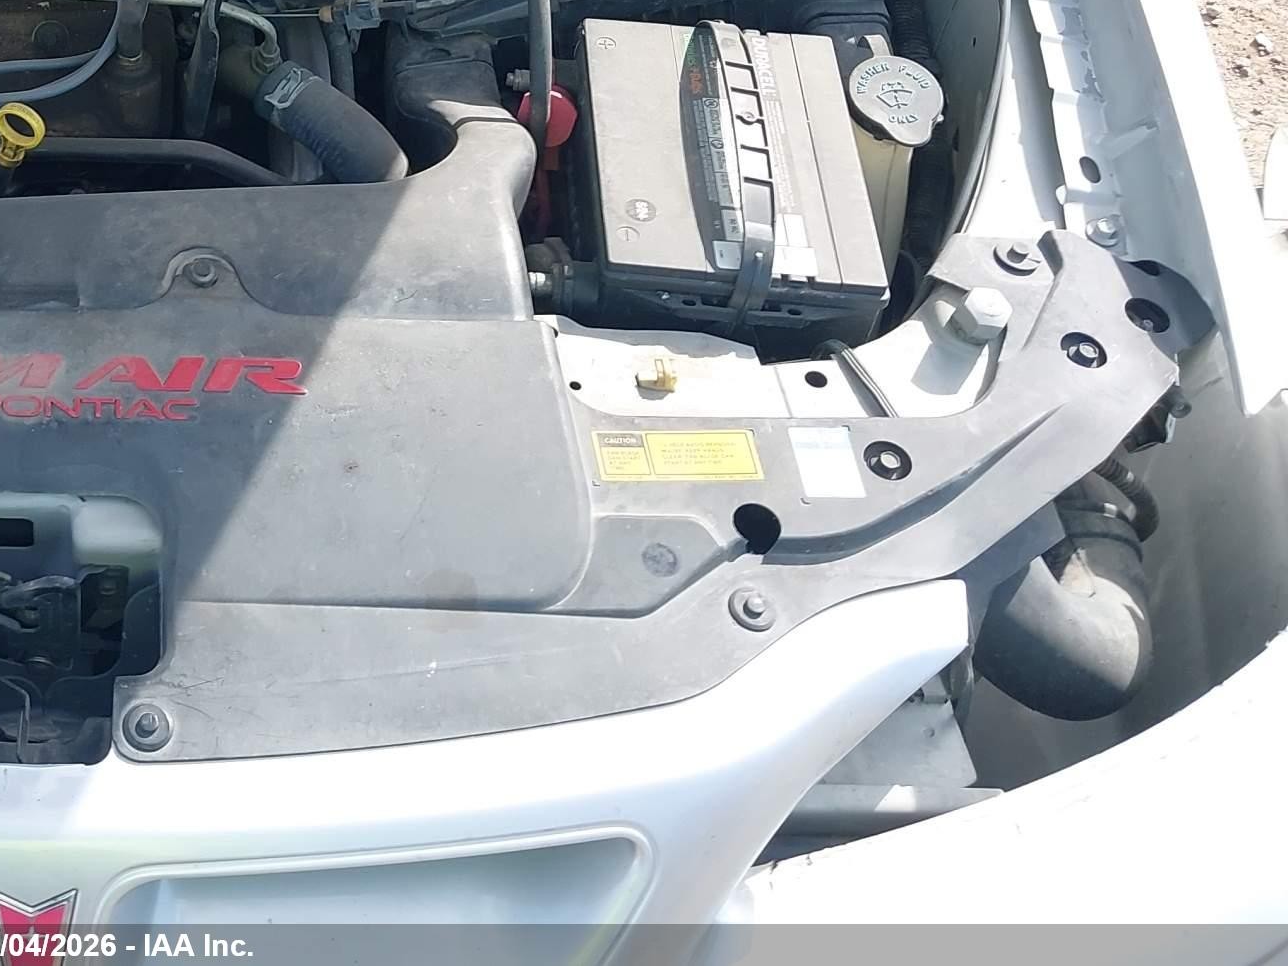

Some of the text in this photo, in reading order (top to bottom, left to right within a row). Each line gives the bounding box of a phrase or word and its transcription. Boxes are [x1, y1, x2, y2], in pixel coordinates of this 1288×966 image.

[752, 36, 777, 97] DURACELL
[856, 62, 931, 95] WASHER FLUID
[888, 114, 919, 125] ONLY
[75, 354, 309, 397] AIR
[604, 436, 637, 444] CAUTION
